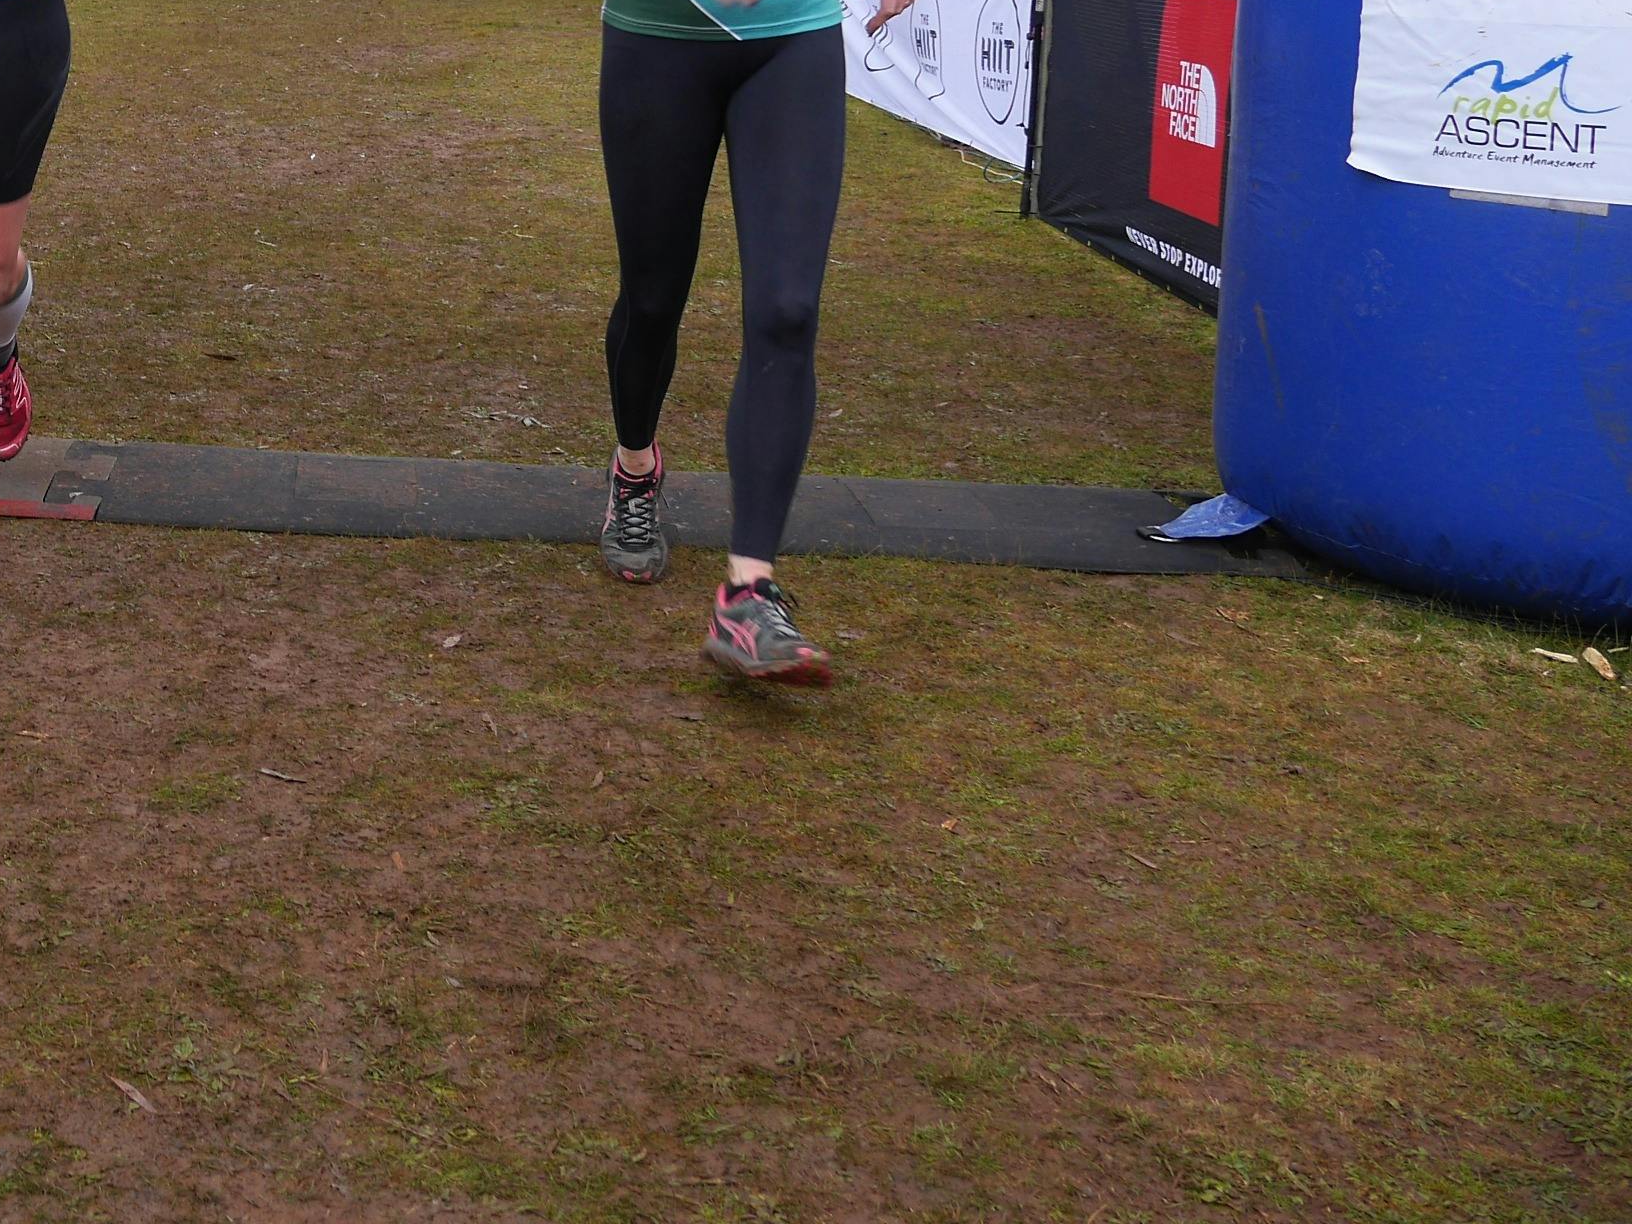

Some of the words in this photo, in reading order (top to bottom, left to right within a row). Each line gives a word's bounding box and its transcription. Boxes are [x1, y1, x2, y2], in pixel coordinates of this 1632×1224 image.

[914, 27, 937, 61] HIIT
[992, 21, 1003, 35] THE
[981, 36, 1015, 74] HIIT
[982, 76, 1009, 93] FACTORY
[1179, 60, 1202, 89] THE
[1161, 83, 1198, 116] NORTH
[1453, 86, 1559, 124] rapid
[1169, 111, 1196, 142] FACE
[1434, 114, 1607, 154] ASCENT
[1432, 145, 1484, 161] Adventure
[1487, 150, 1519, 164] Event
[1522, 153, 1597, 169] Management
[1126, 226, 1159, 256] NEVER
[1159, 240, 1182, 267] STOP
